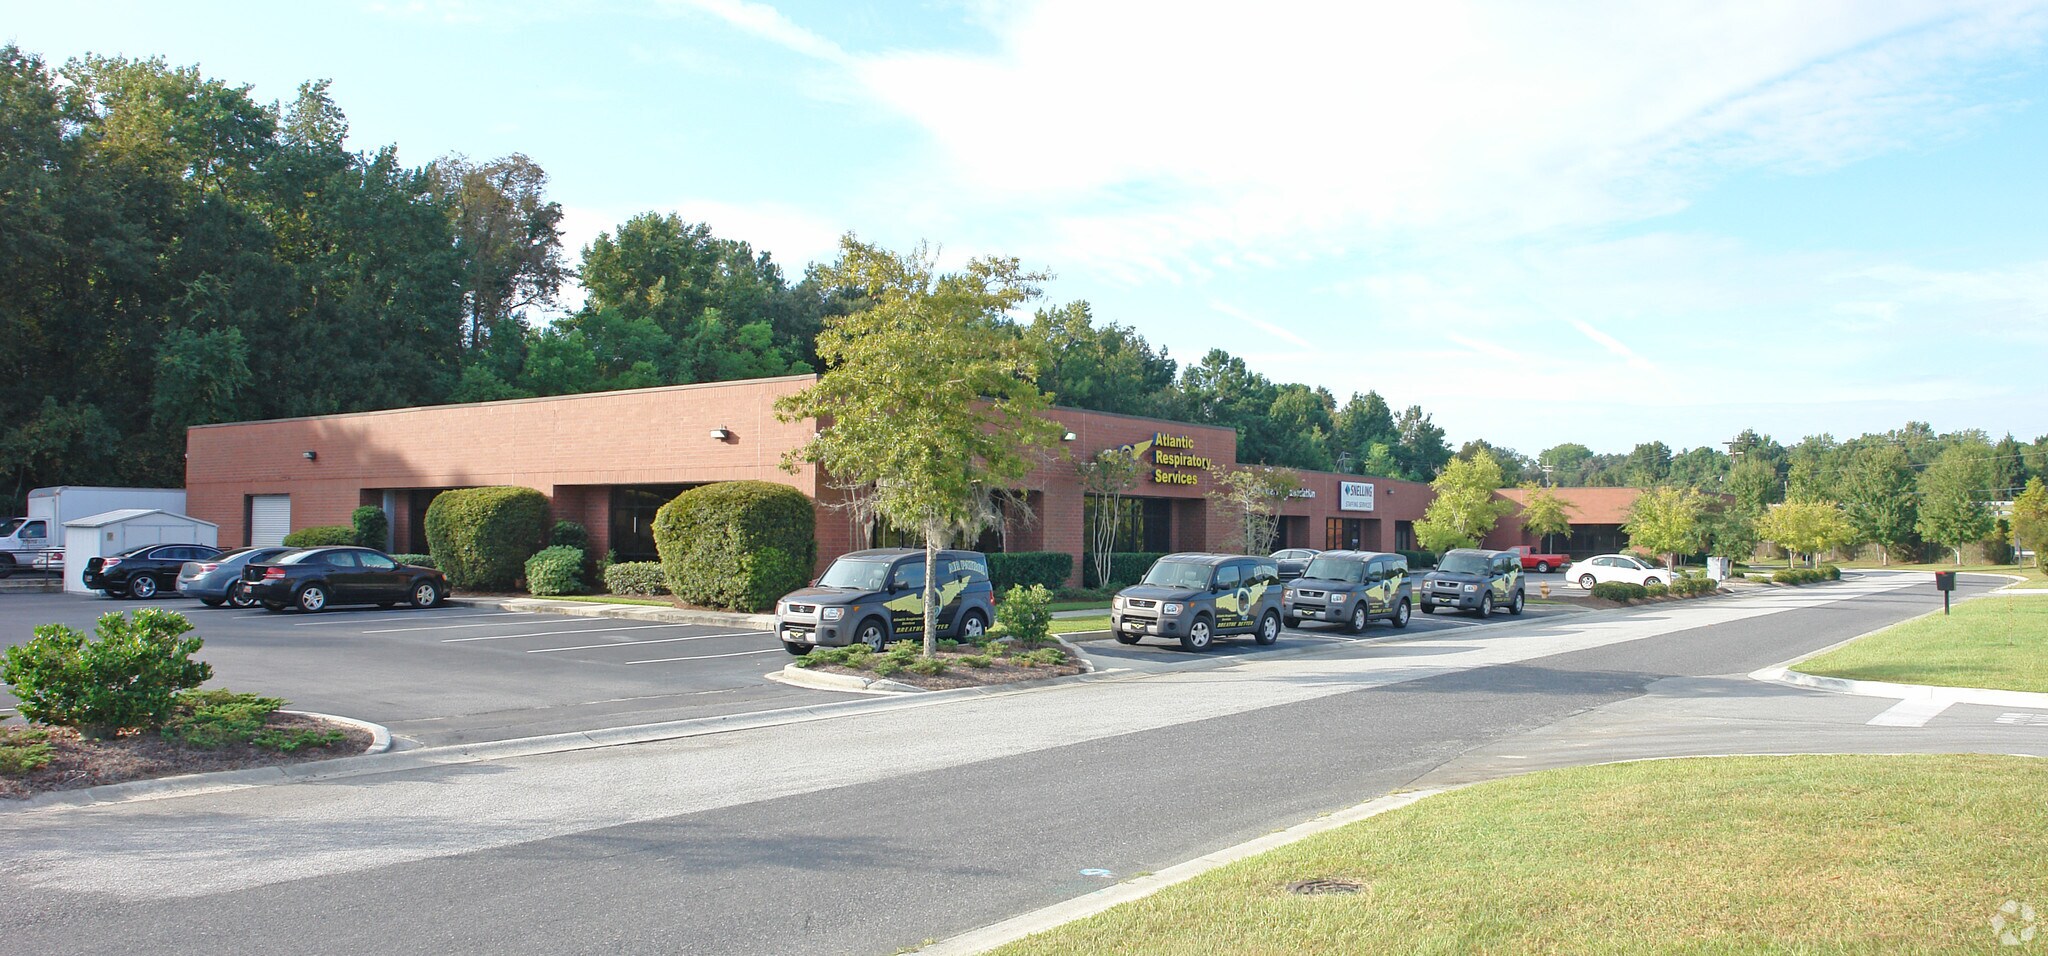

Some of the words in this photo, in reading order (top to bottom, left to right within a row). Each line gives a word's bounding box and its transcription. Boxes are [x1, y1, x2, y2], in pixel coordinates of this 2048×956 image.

[1155, 432, 1194, 449] Atlantic
[1156, 450, 1211, 470] Respiratory
[1155, 468, 1198, 485] Services
[1350, 484, 1373, 497] SNELLING
